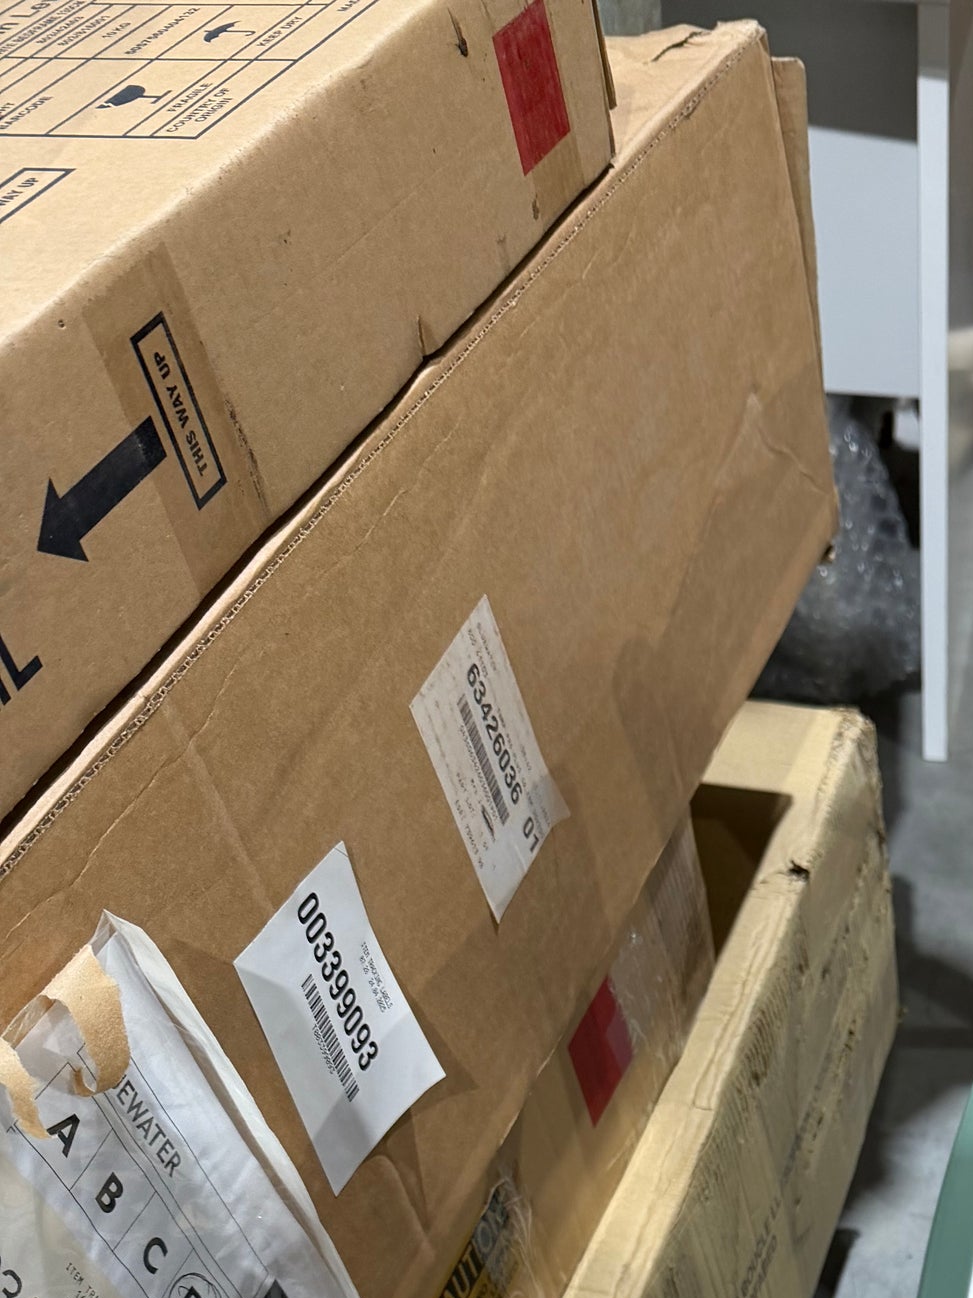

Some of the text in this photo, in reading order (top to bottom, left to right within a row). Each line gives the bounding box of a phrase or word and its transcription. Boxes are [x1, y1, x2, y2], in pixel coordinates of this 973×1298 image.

[256, 16, 302, 48] KEEP DRY
[167, 82, 213, 113] FRAGILE
[154, 351, 208, 477] THIS WAY UP
[466, 663, 523, 805] 63426036
[523, 816, 540, 852] 01
[297, 892, 379, 1071] 003399093
[47, 1113, 80, 1158] A
[117, 1075, 181, 1178] EWATER
[95, 1172, 124, 1214] B
[65, 1262, 84, 1285] ITEM
[143, 1237, 168, 1275] C
